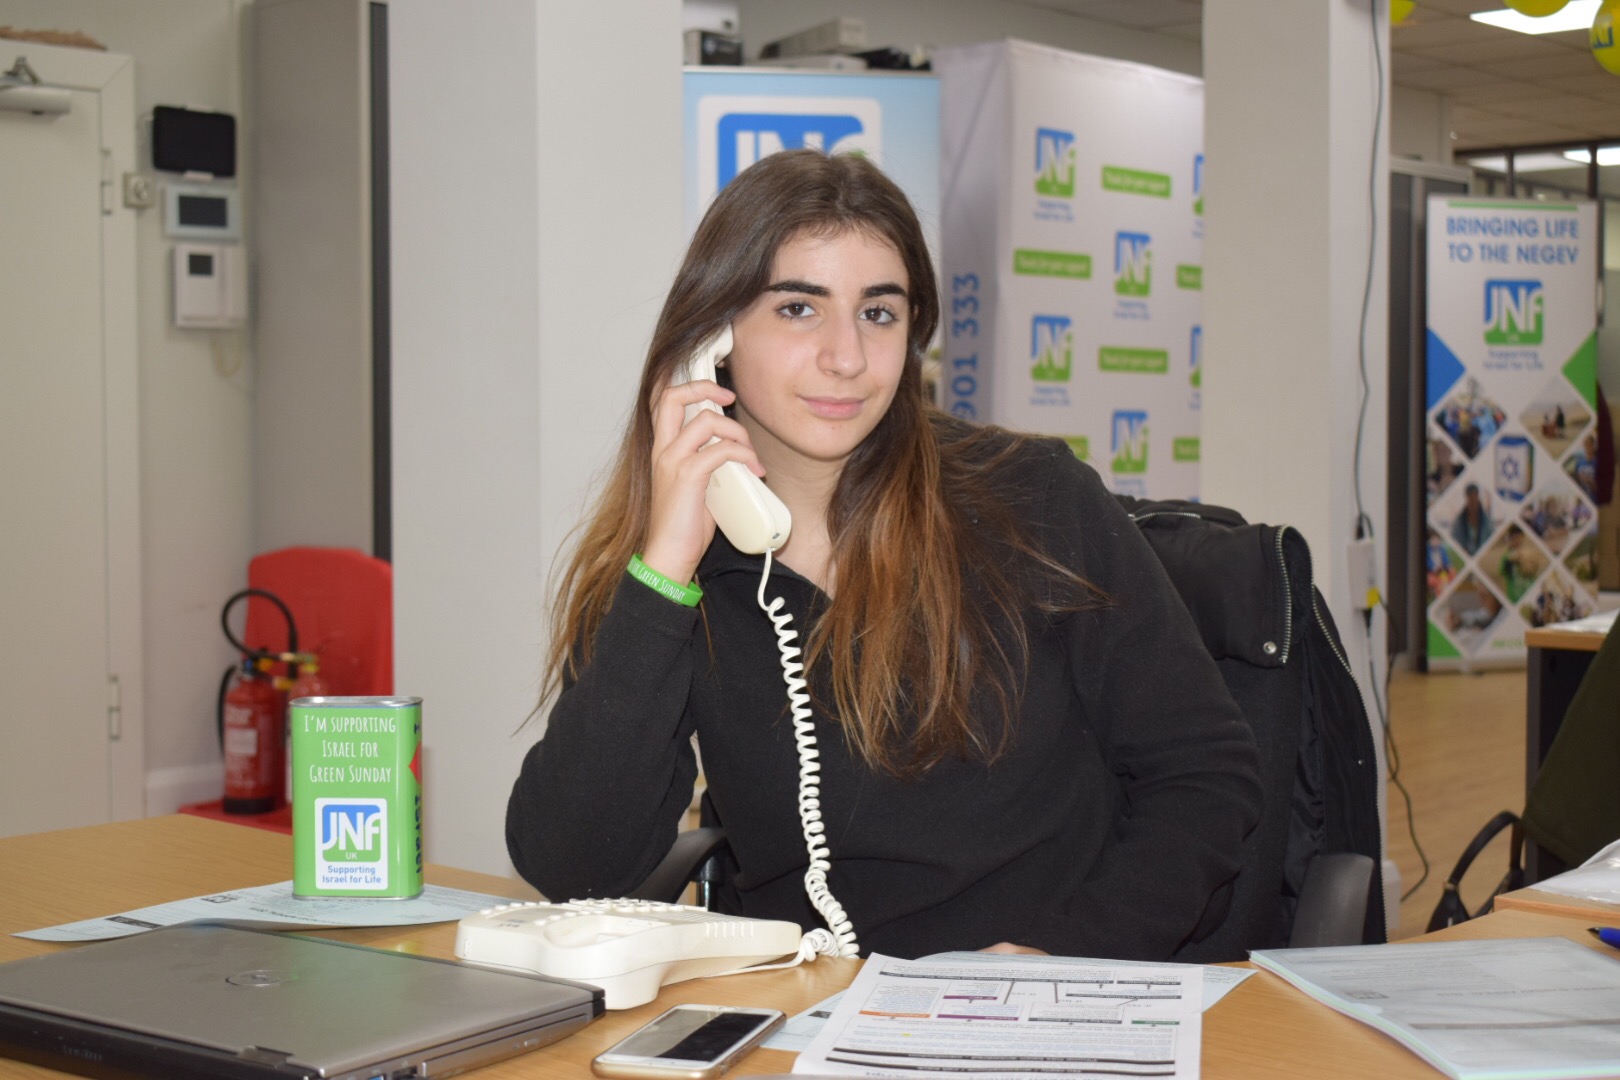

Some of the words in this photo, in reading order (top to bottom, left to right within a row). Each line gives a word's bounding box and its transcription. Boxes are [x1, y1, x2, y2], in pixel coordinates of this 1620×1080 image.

[1446, 217, 1539, 238] BRINGING
[1545, 219, 1579, 239] LIFE
[1447, 243, 1473, 263] TO
[1479, 244, 1509, 264] THE
[1516, 245, 1579, 264] NEGEV
[951, 272, 979, 338] 333
[331, 716, 396, 733] SUPPORTING
[360, 742, 379, 758] FOR
[345, 852, 358, 860] UK
[327, 865, 376, 875] Supporting
[322, 875, 348, 884] Israel
[349, 875, 362, 884] for
[364, 875, 382, 884] Life
